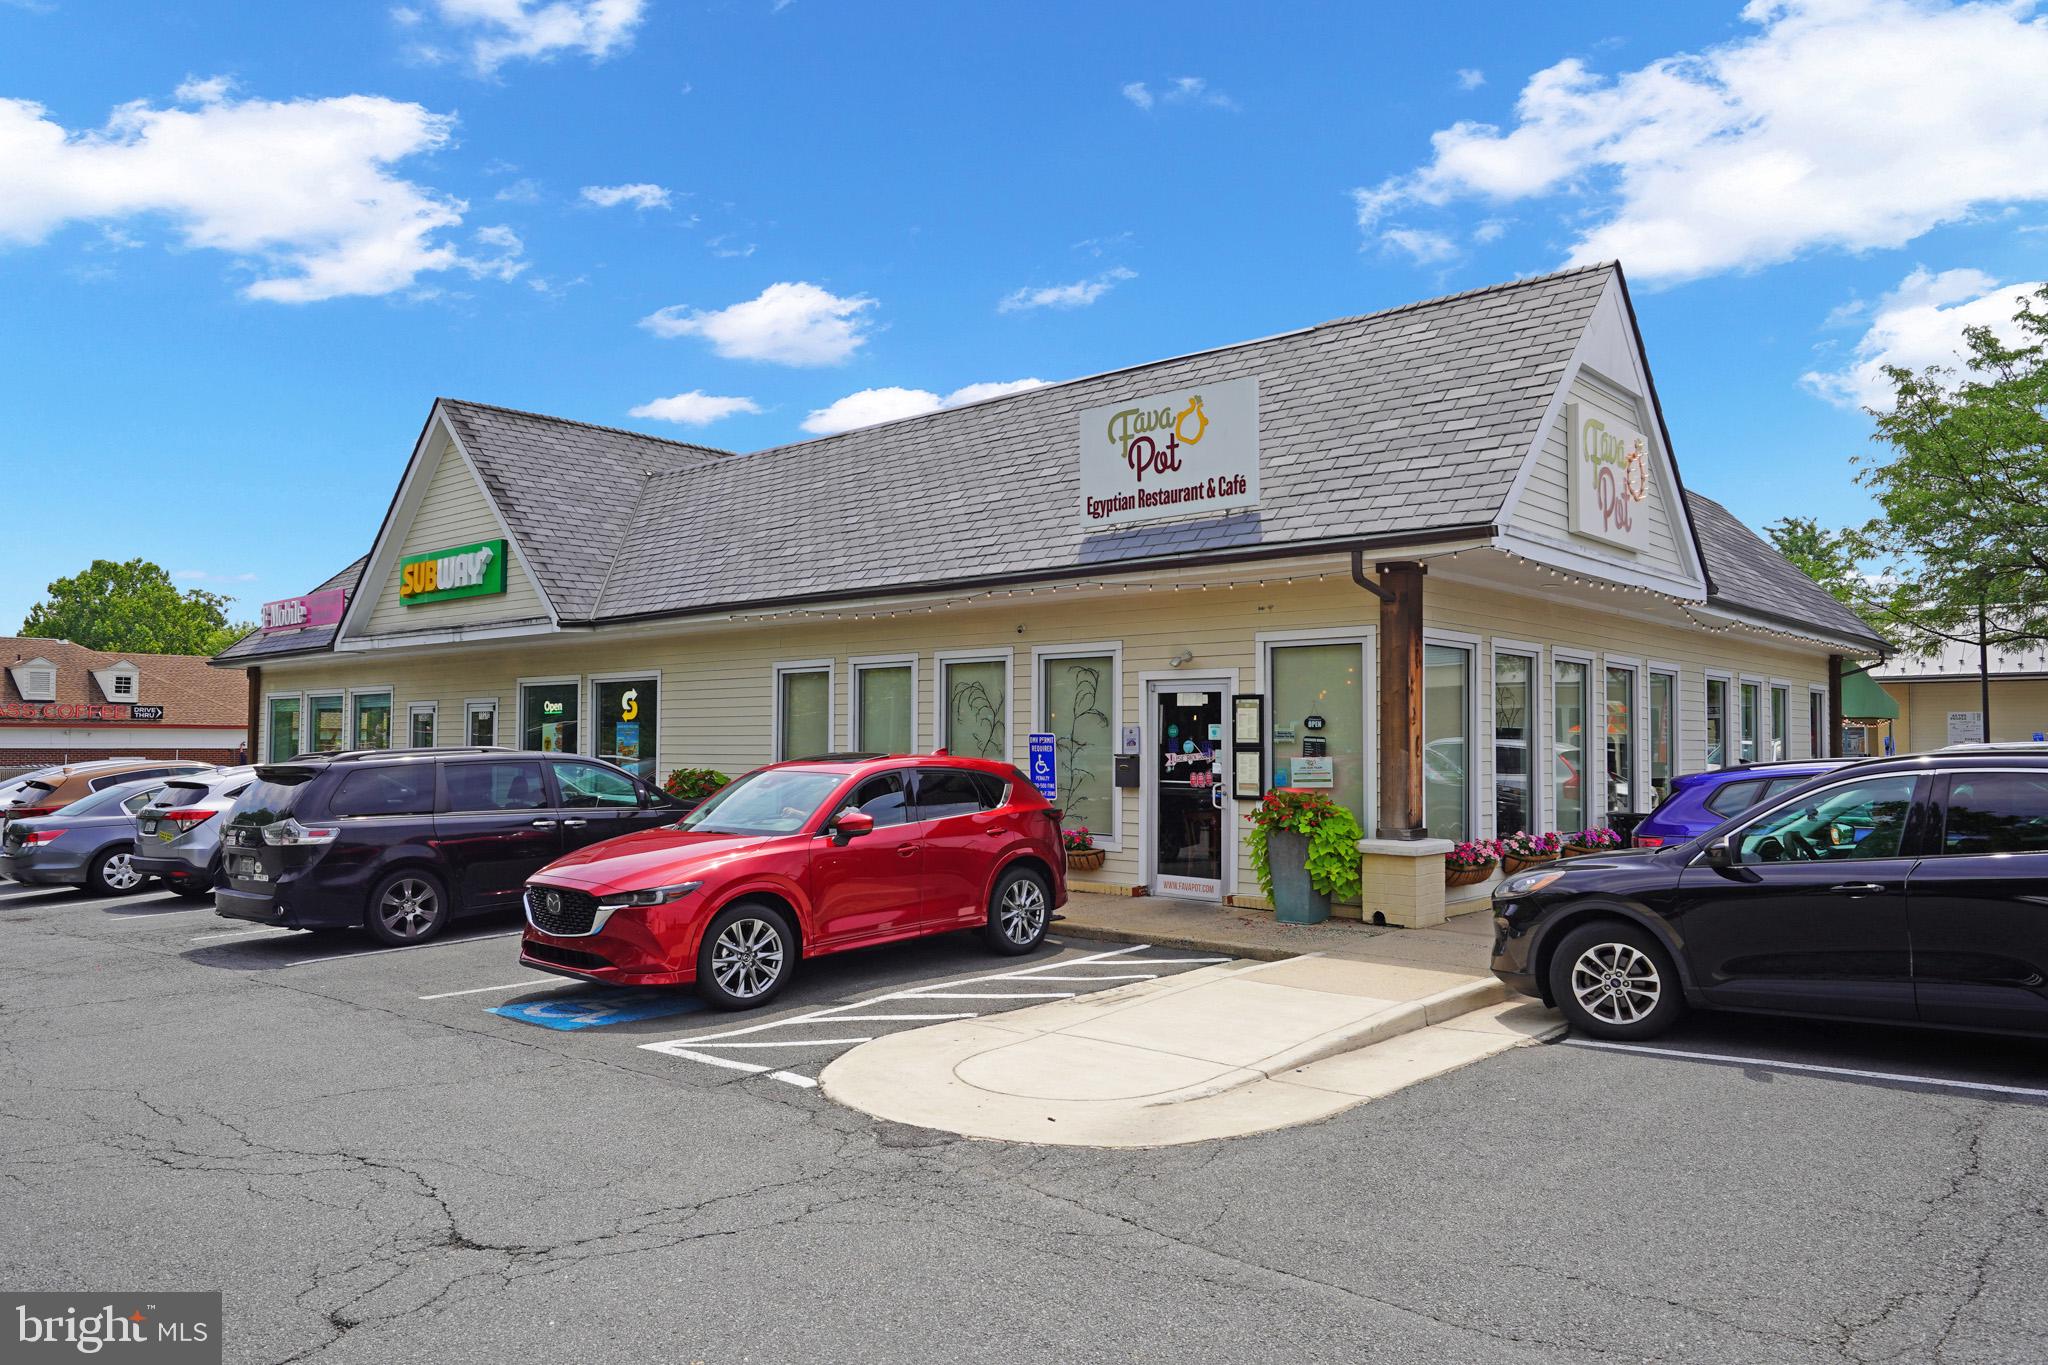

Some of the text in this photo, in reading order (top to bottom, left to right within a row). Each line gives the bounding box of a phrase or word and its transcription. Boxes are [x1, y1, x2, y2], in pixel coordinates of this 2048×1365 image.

[1108, 407, 1176, 458] Fava
[1128, 433, 1182, 482] Pot
[1583, 418, 1627, 490] Fava
[1087, 474, 1247, 519] Egyptian Restaurant & Café
[1598, 466, 1632, 533] Pot
[400, 547, 494, 598] SUBWAY
[261, 599, 307, 629] T-Mobile
[41, 704, 128, 719] COFFEE
[544, 701, 563, 713] Open
[1307, 720, 1322, 728] OPEN
[1039, 736, 1054, 744] PERMIT
[1163, 880, 1215, 893] WWW.FAVAPOT.COM
